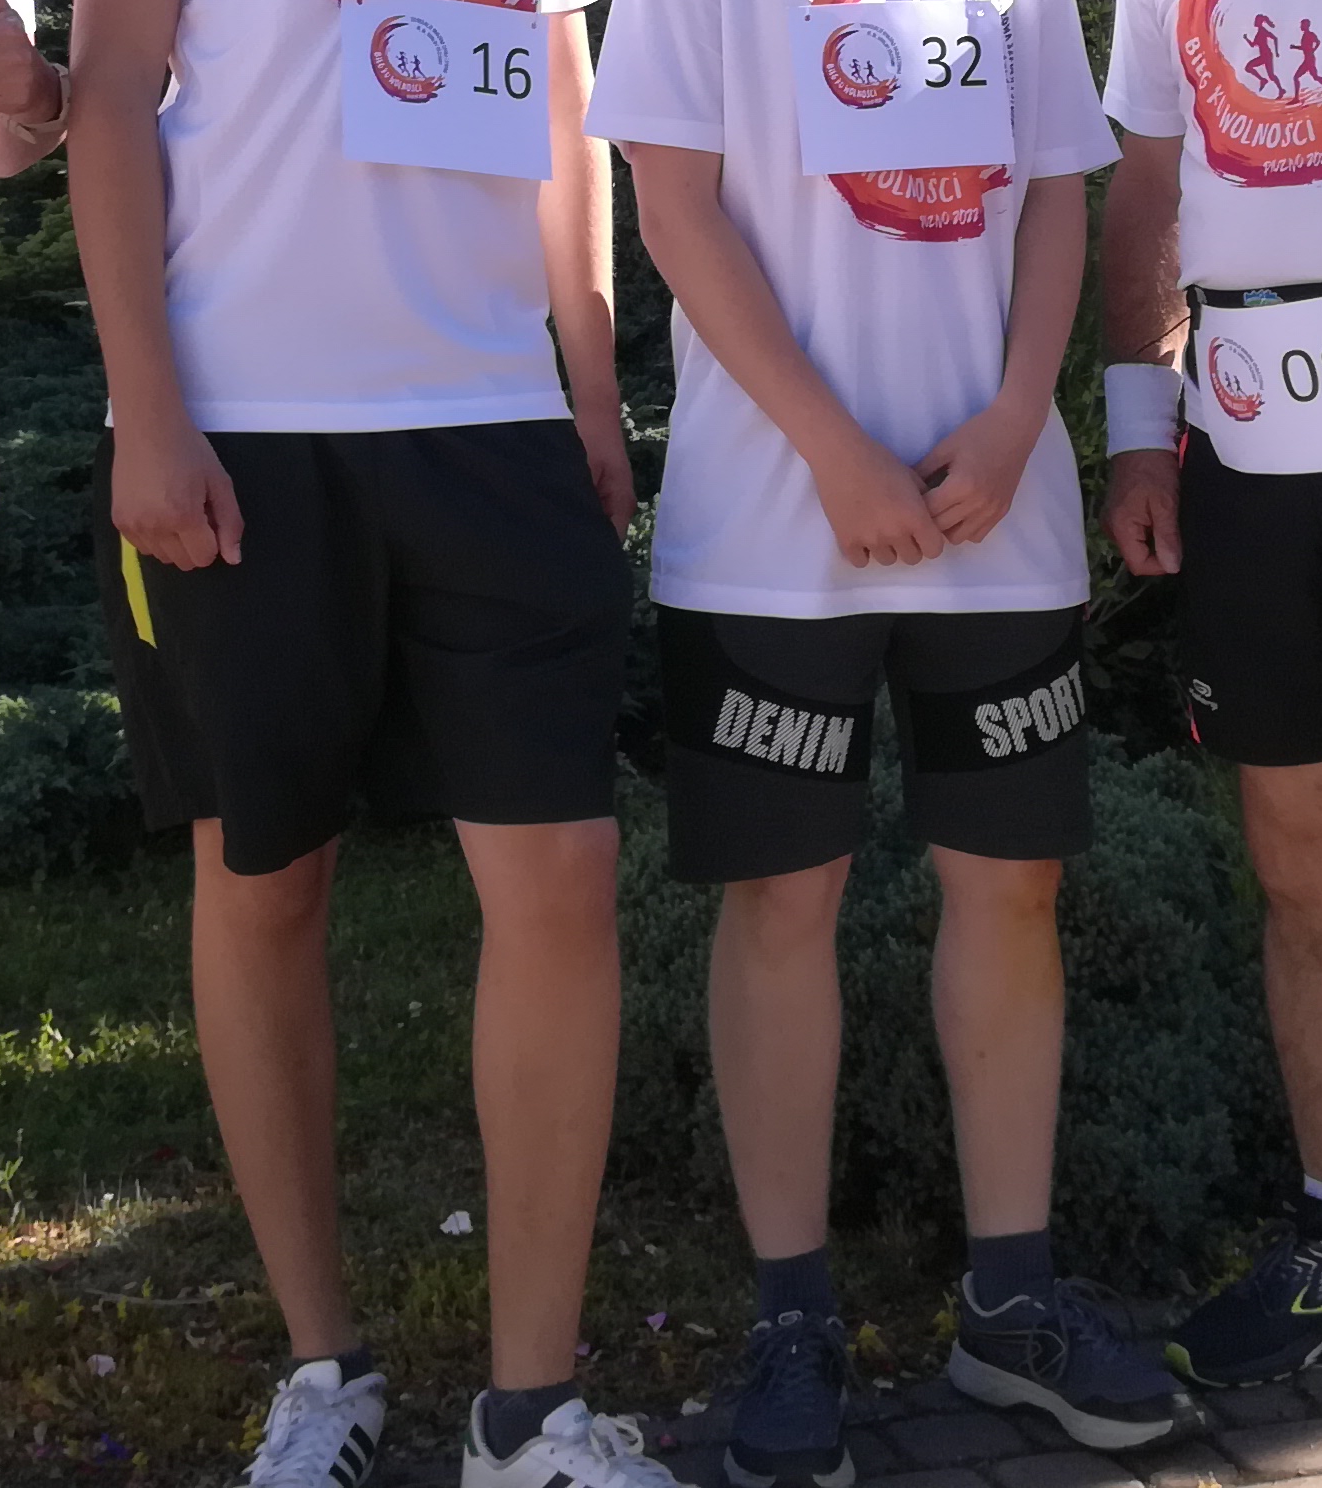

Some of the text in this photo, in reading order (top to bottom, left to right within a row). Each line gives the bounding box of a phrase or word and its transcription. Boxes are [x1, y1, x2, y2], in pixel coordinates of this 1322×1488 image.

[473, 42, 532, 100] 16
[922, 36, 987, 89] 32
[1185, 36, 1212, 90] BIEG
[1218, 107, 1316, 148] WOLNOŚCI
[712, 688, 855, 774] DENIM
